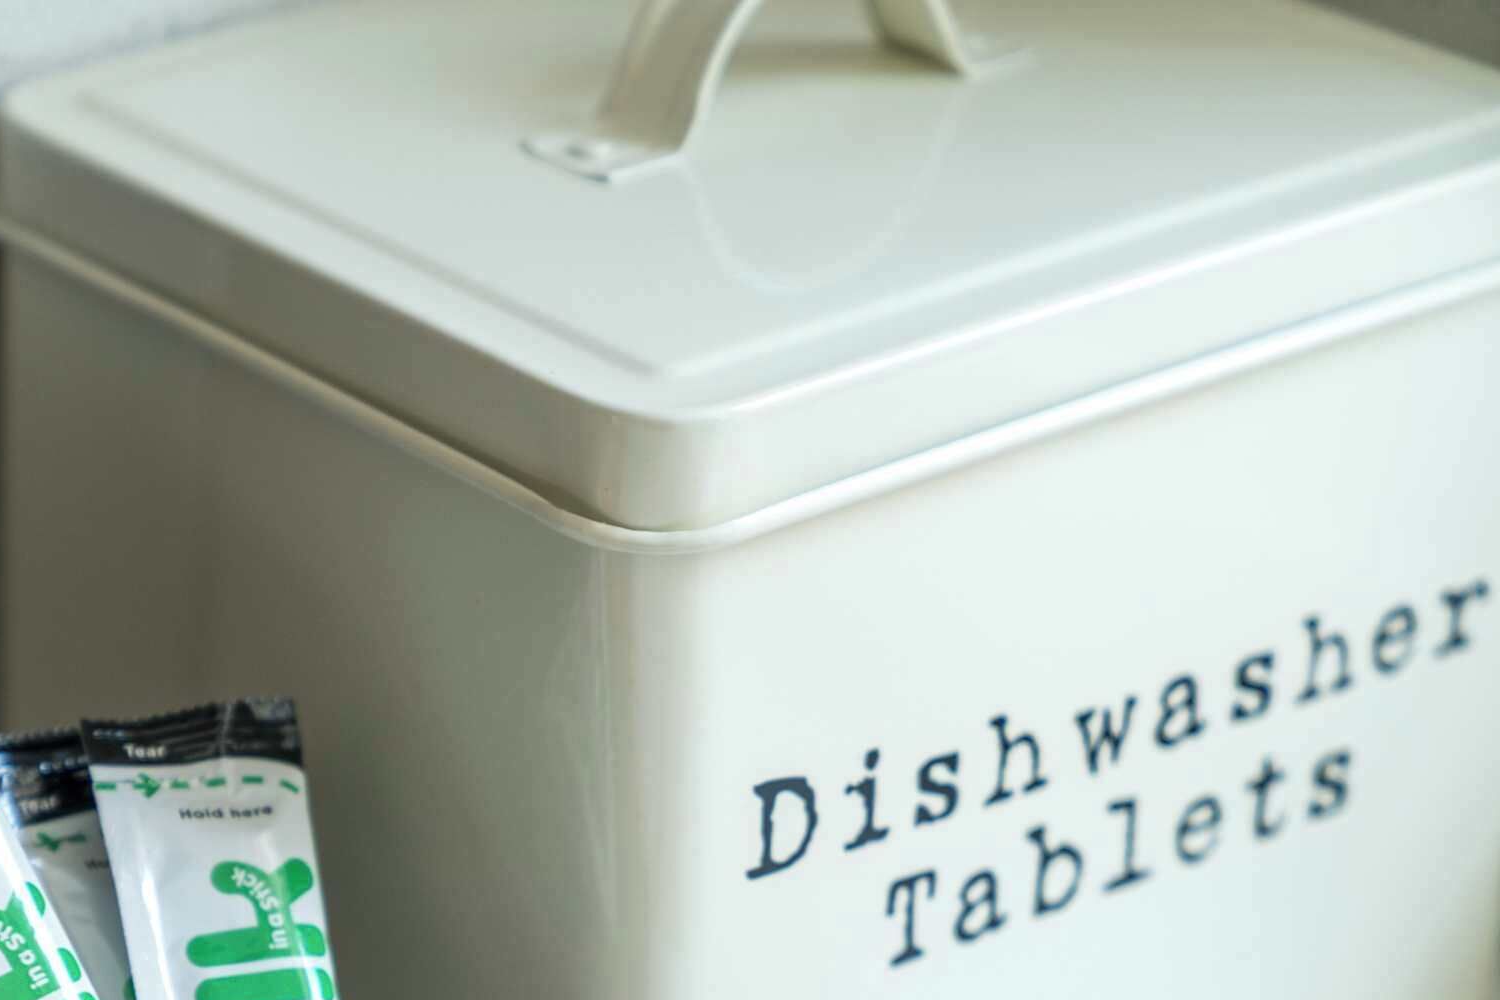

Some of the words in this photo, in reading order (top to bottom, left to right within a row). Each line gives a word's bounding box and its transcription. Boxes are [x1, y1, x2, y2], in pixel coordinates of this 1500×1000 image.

[746, 577, 1489, 880] Dishwasher
[124, 743, 167, 760] Tear
[178, 806, 224, 821] Hold
[229, 804, 274, 819] here
[885, 748, 1353, 968] Tablets
[230, 866, 281, 912] Stick
[268, 912, 284, 929] a
[268, 929, 289, 950] in
[18, 949, 36, 966] a
[27, 965, 50, 990] in
